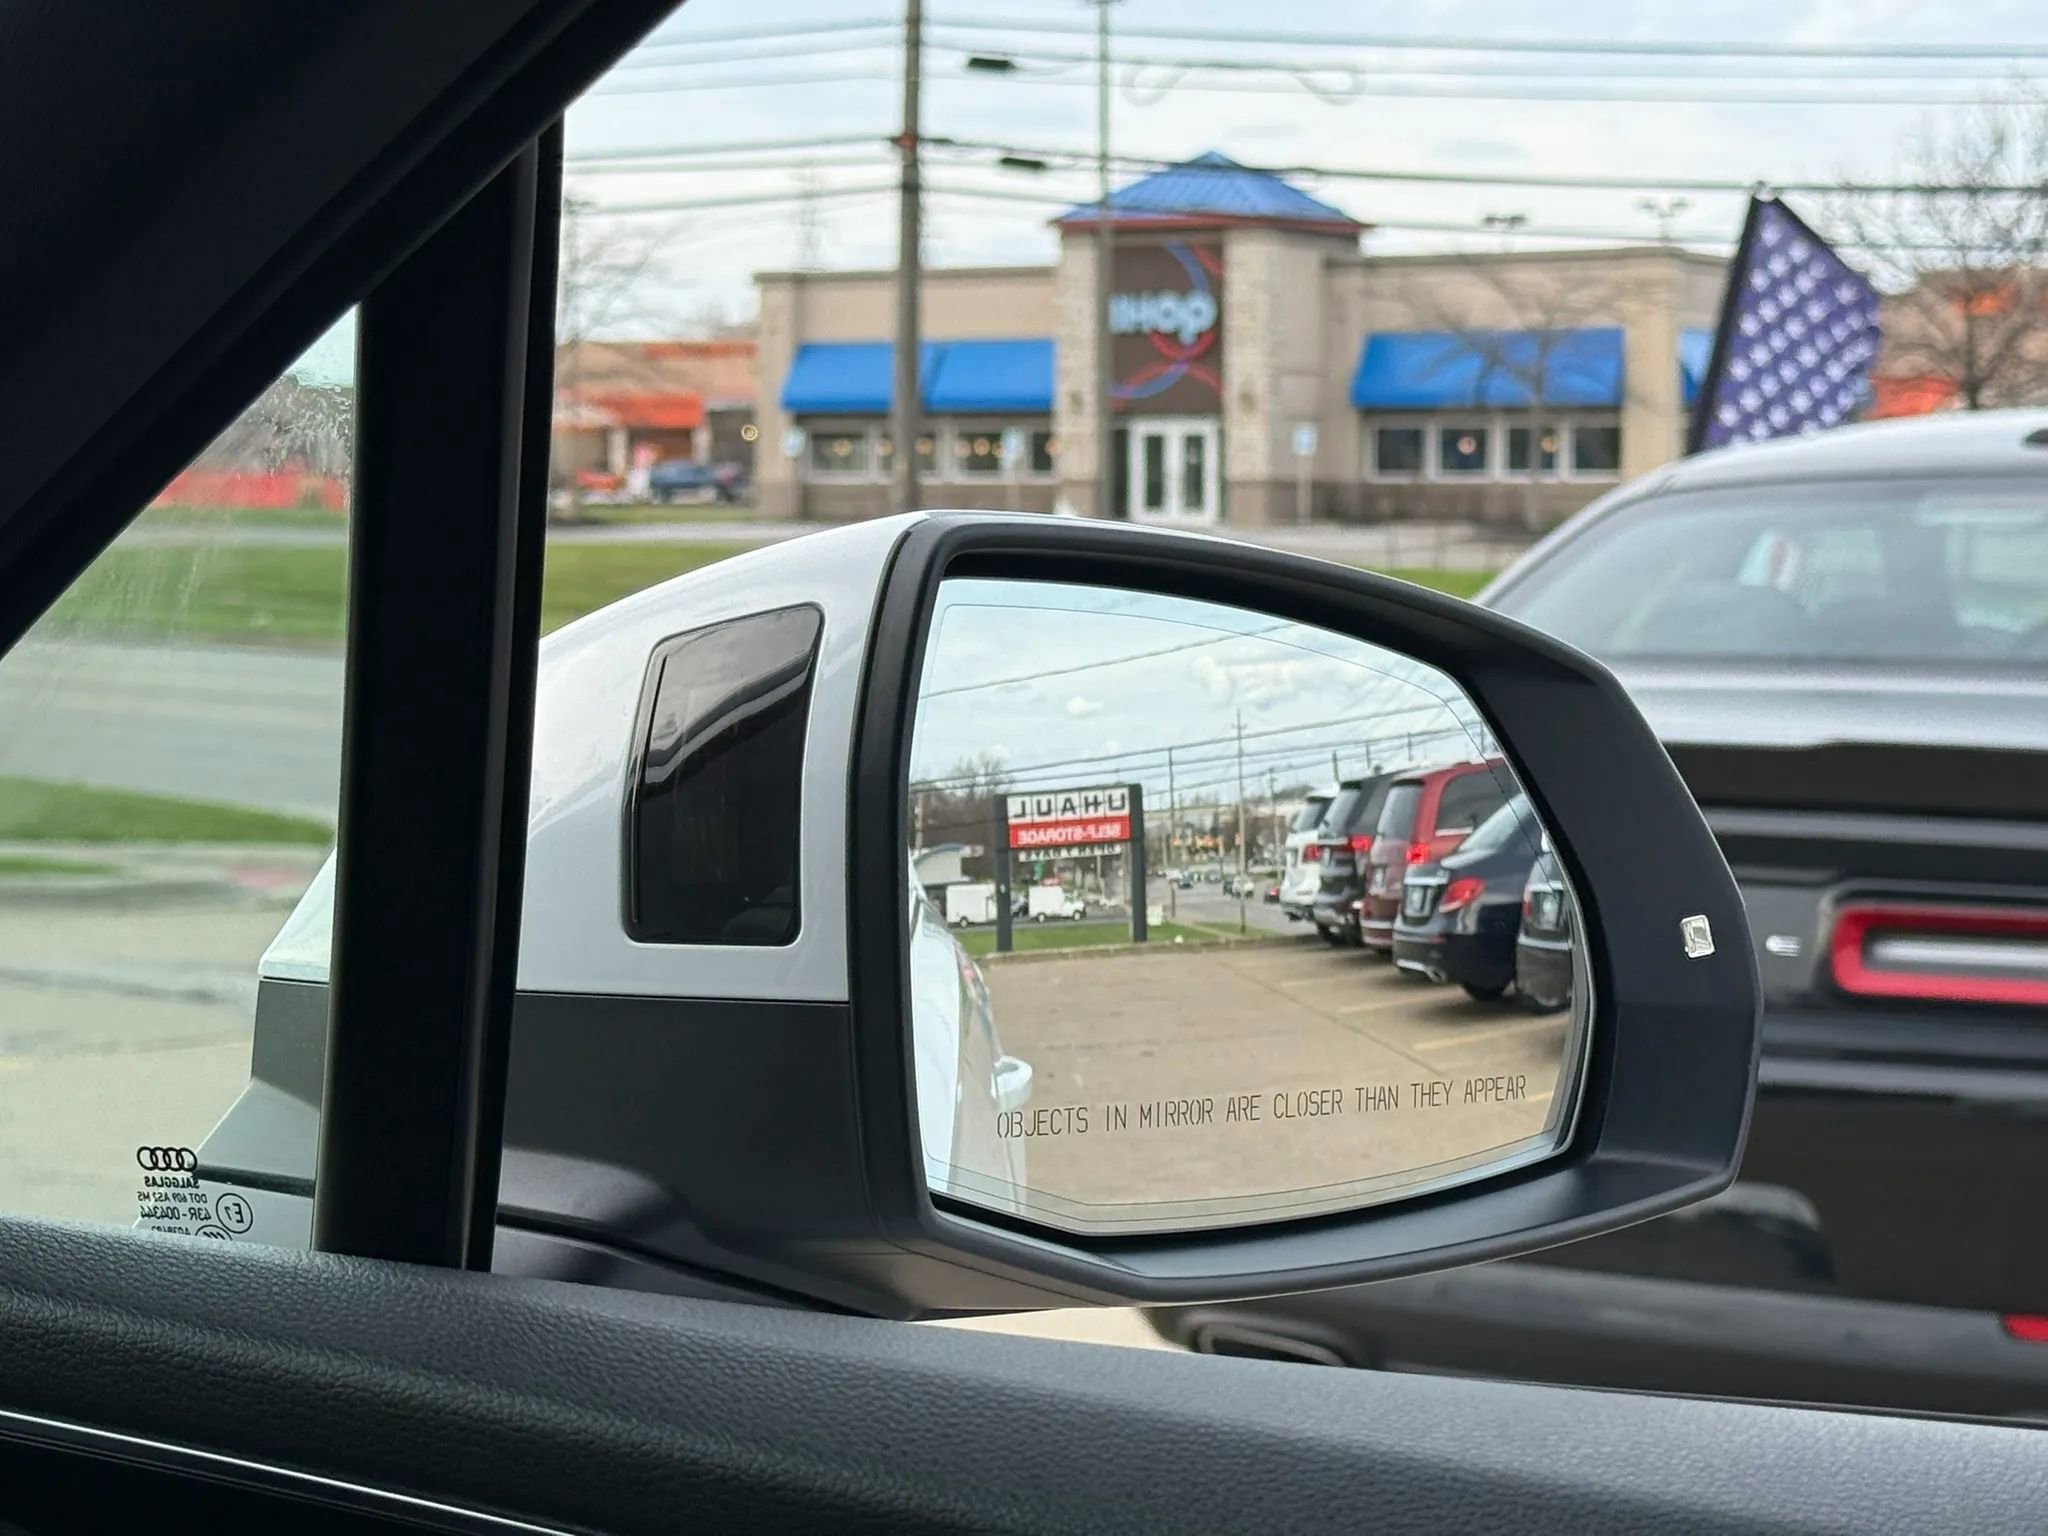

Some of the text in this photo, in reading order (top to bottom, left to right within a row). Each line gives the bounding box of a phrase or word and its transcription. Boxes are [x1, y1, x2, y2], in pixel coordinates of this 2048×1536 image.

[996, 1074, 1527, 1138] OBJECTS IN MIRROR ARE CLOSER THAN THEY APPEAR
